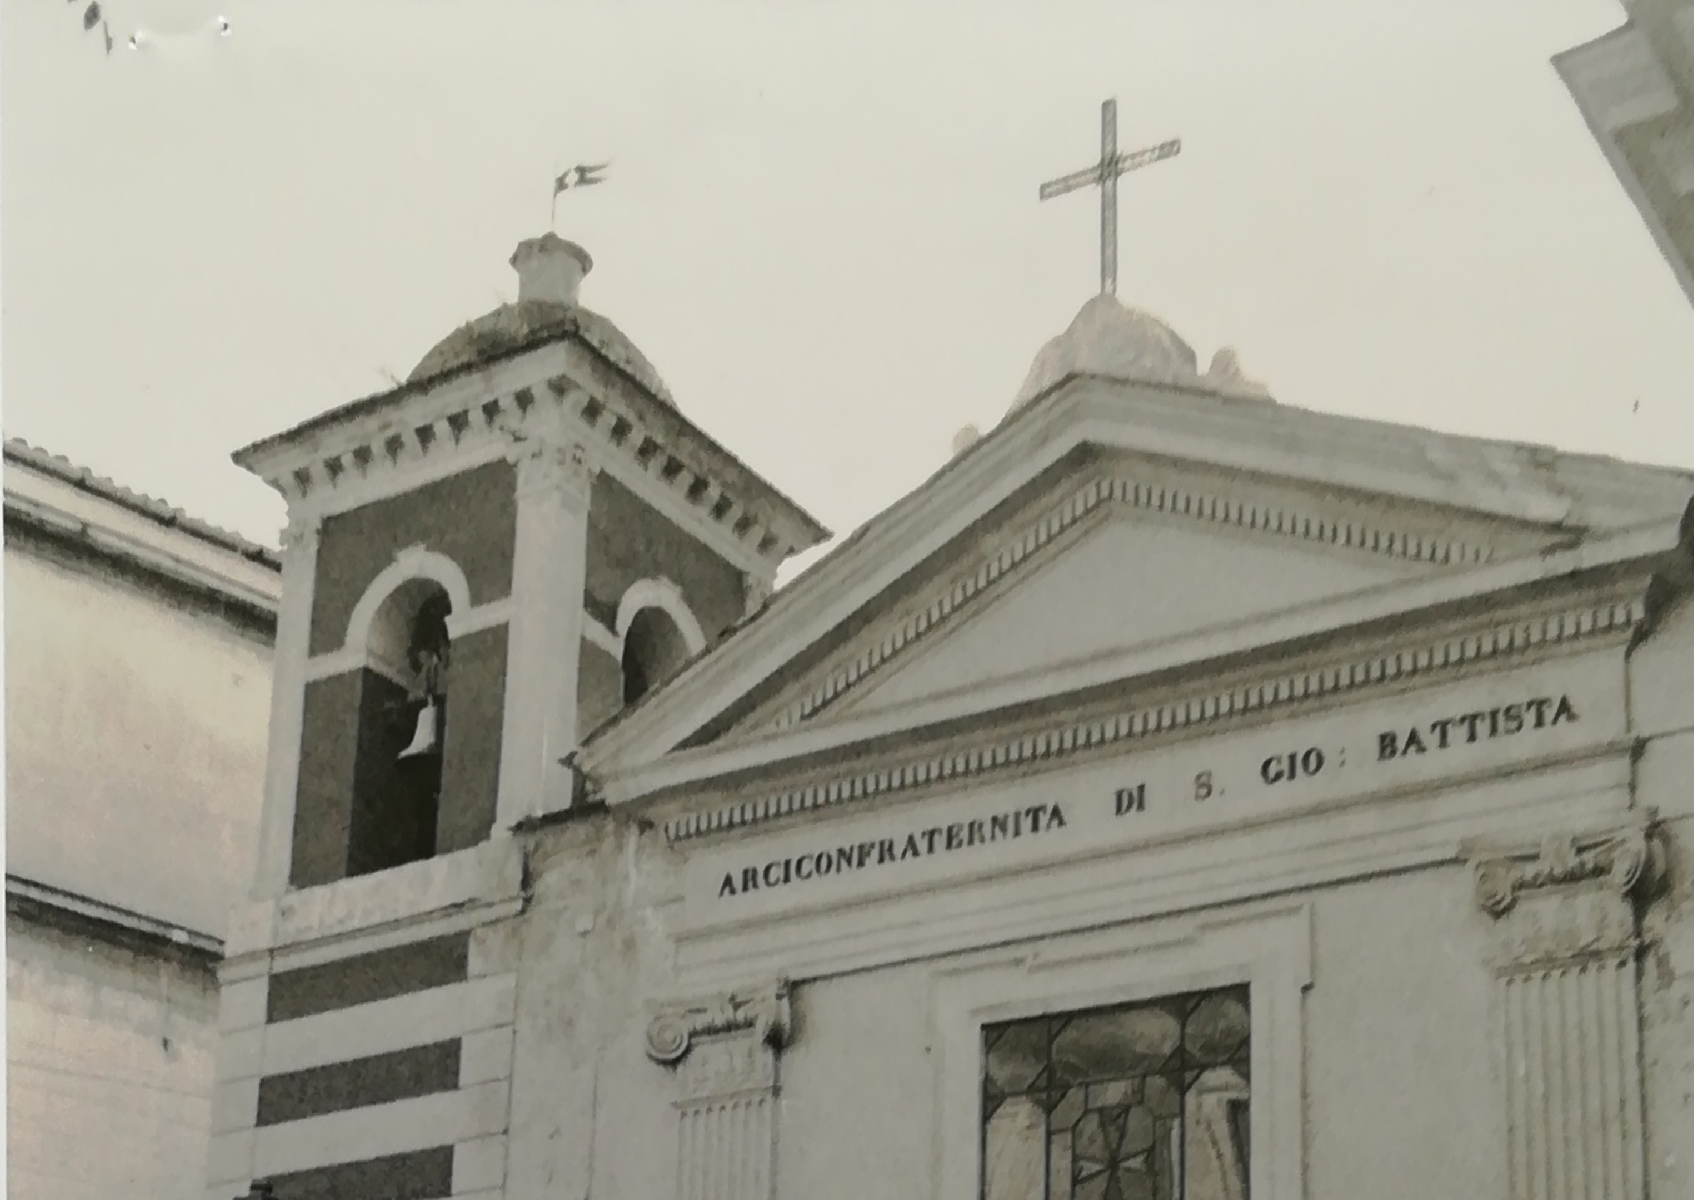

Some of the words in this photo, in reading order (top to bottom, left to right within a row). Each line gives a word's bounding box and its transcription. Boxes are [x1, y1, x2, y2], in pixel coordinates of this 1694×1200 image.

[718, 803, 1068, 899] ARCICONFRATERNITA
[1115, 784, 1147, 817] DI
[1194, 771, 1225, 803] S.
[1378, 695, 1579, 762] BATTISTA
